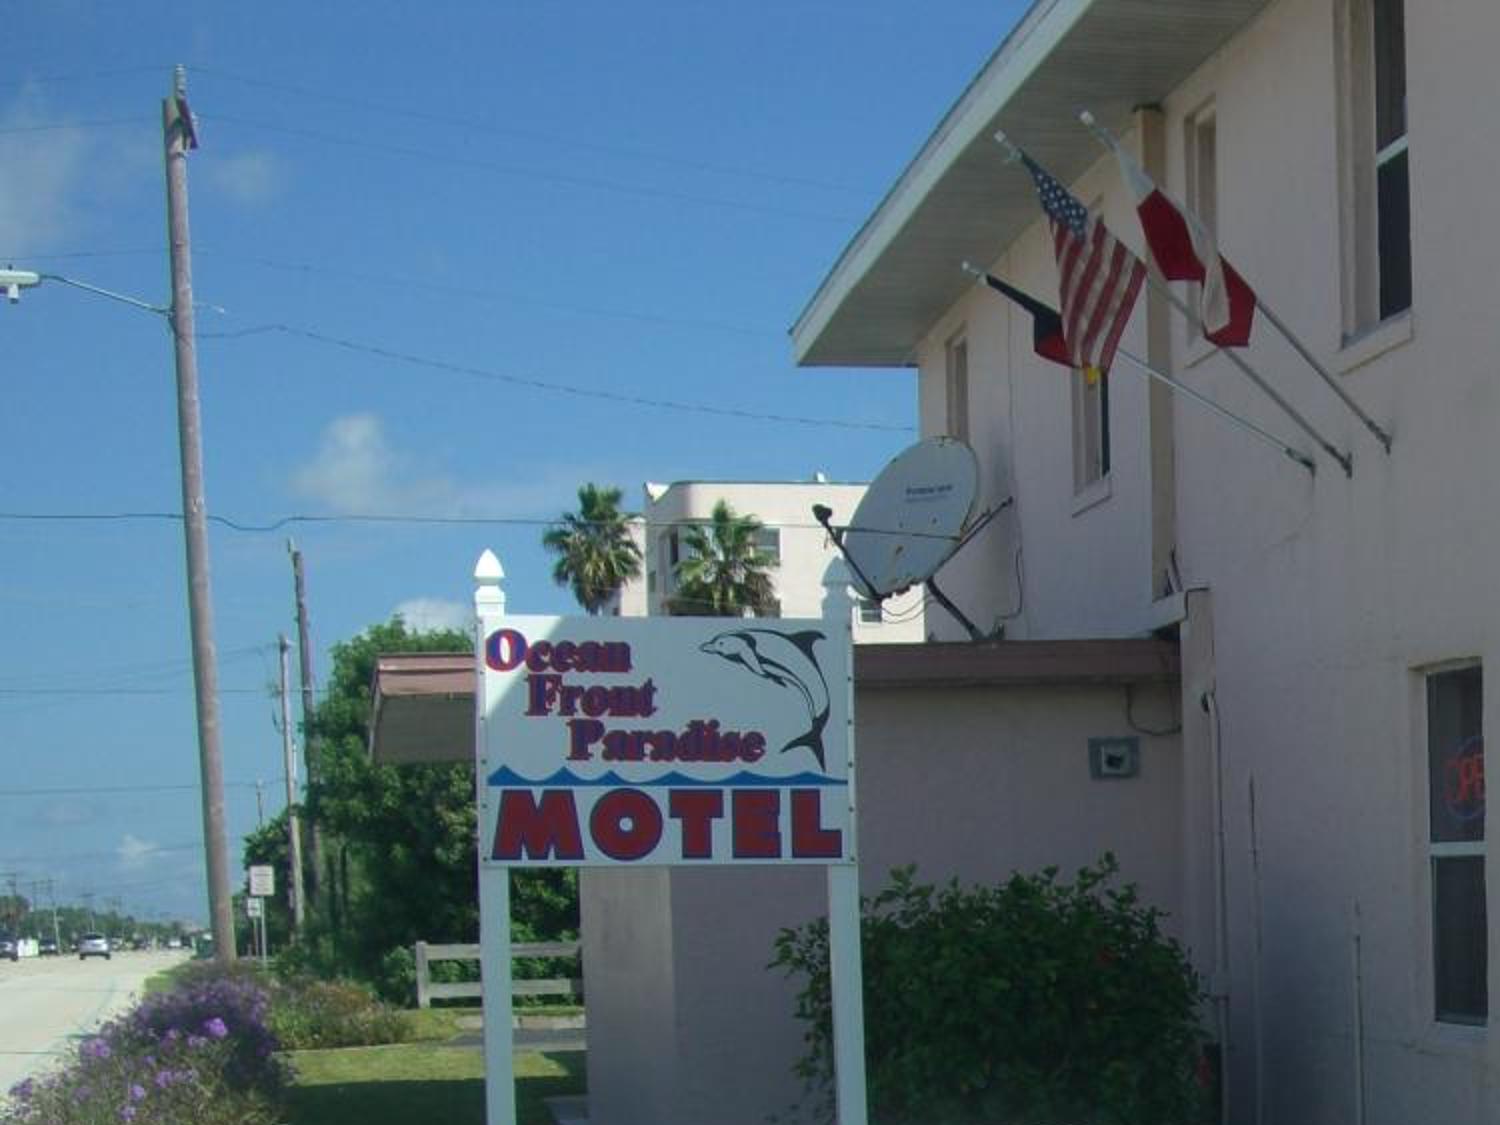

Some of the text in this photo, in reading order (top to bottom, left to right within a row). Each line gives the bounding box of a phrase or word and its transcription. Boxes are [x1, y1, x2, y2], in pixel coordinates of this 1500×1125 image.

[485, 628, 632, 673] Ocean
[525, 674, 658, 716] Front
[567, 718, 767, 763] Paradise
[492, 787, 843, 861] MOTEL
